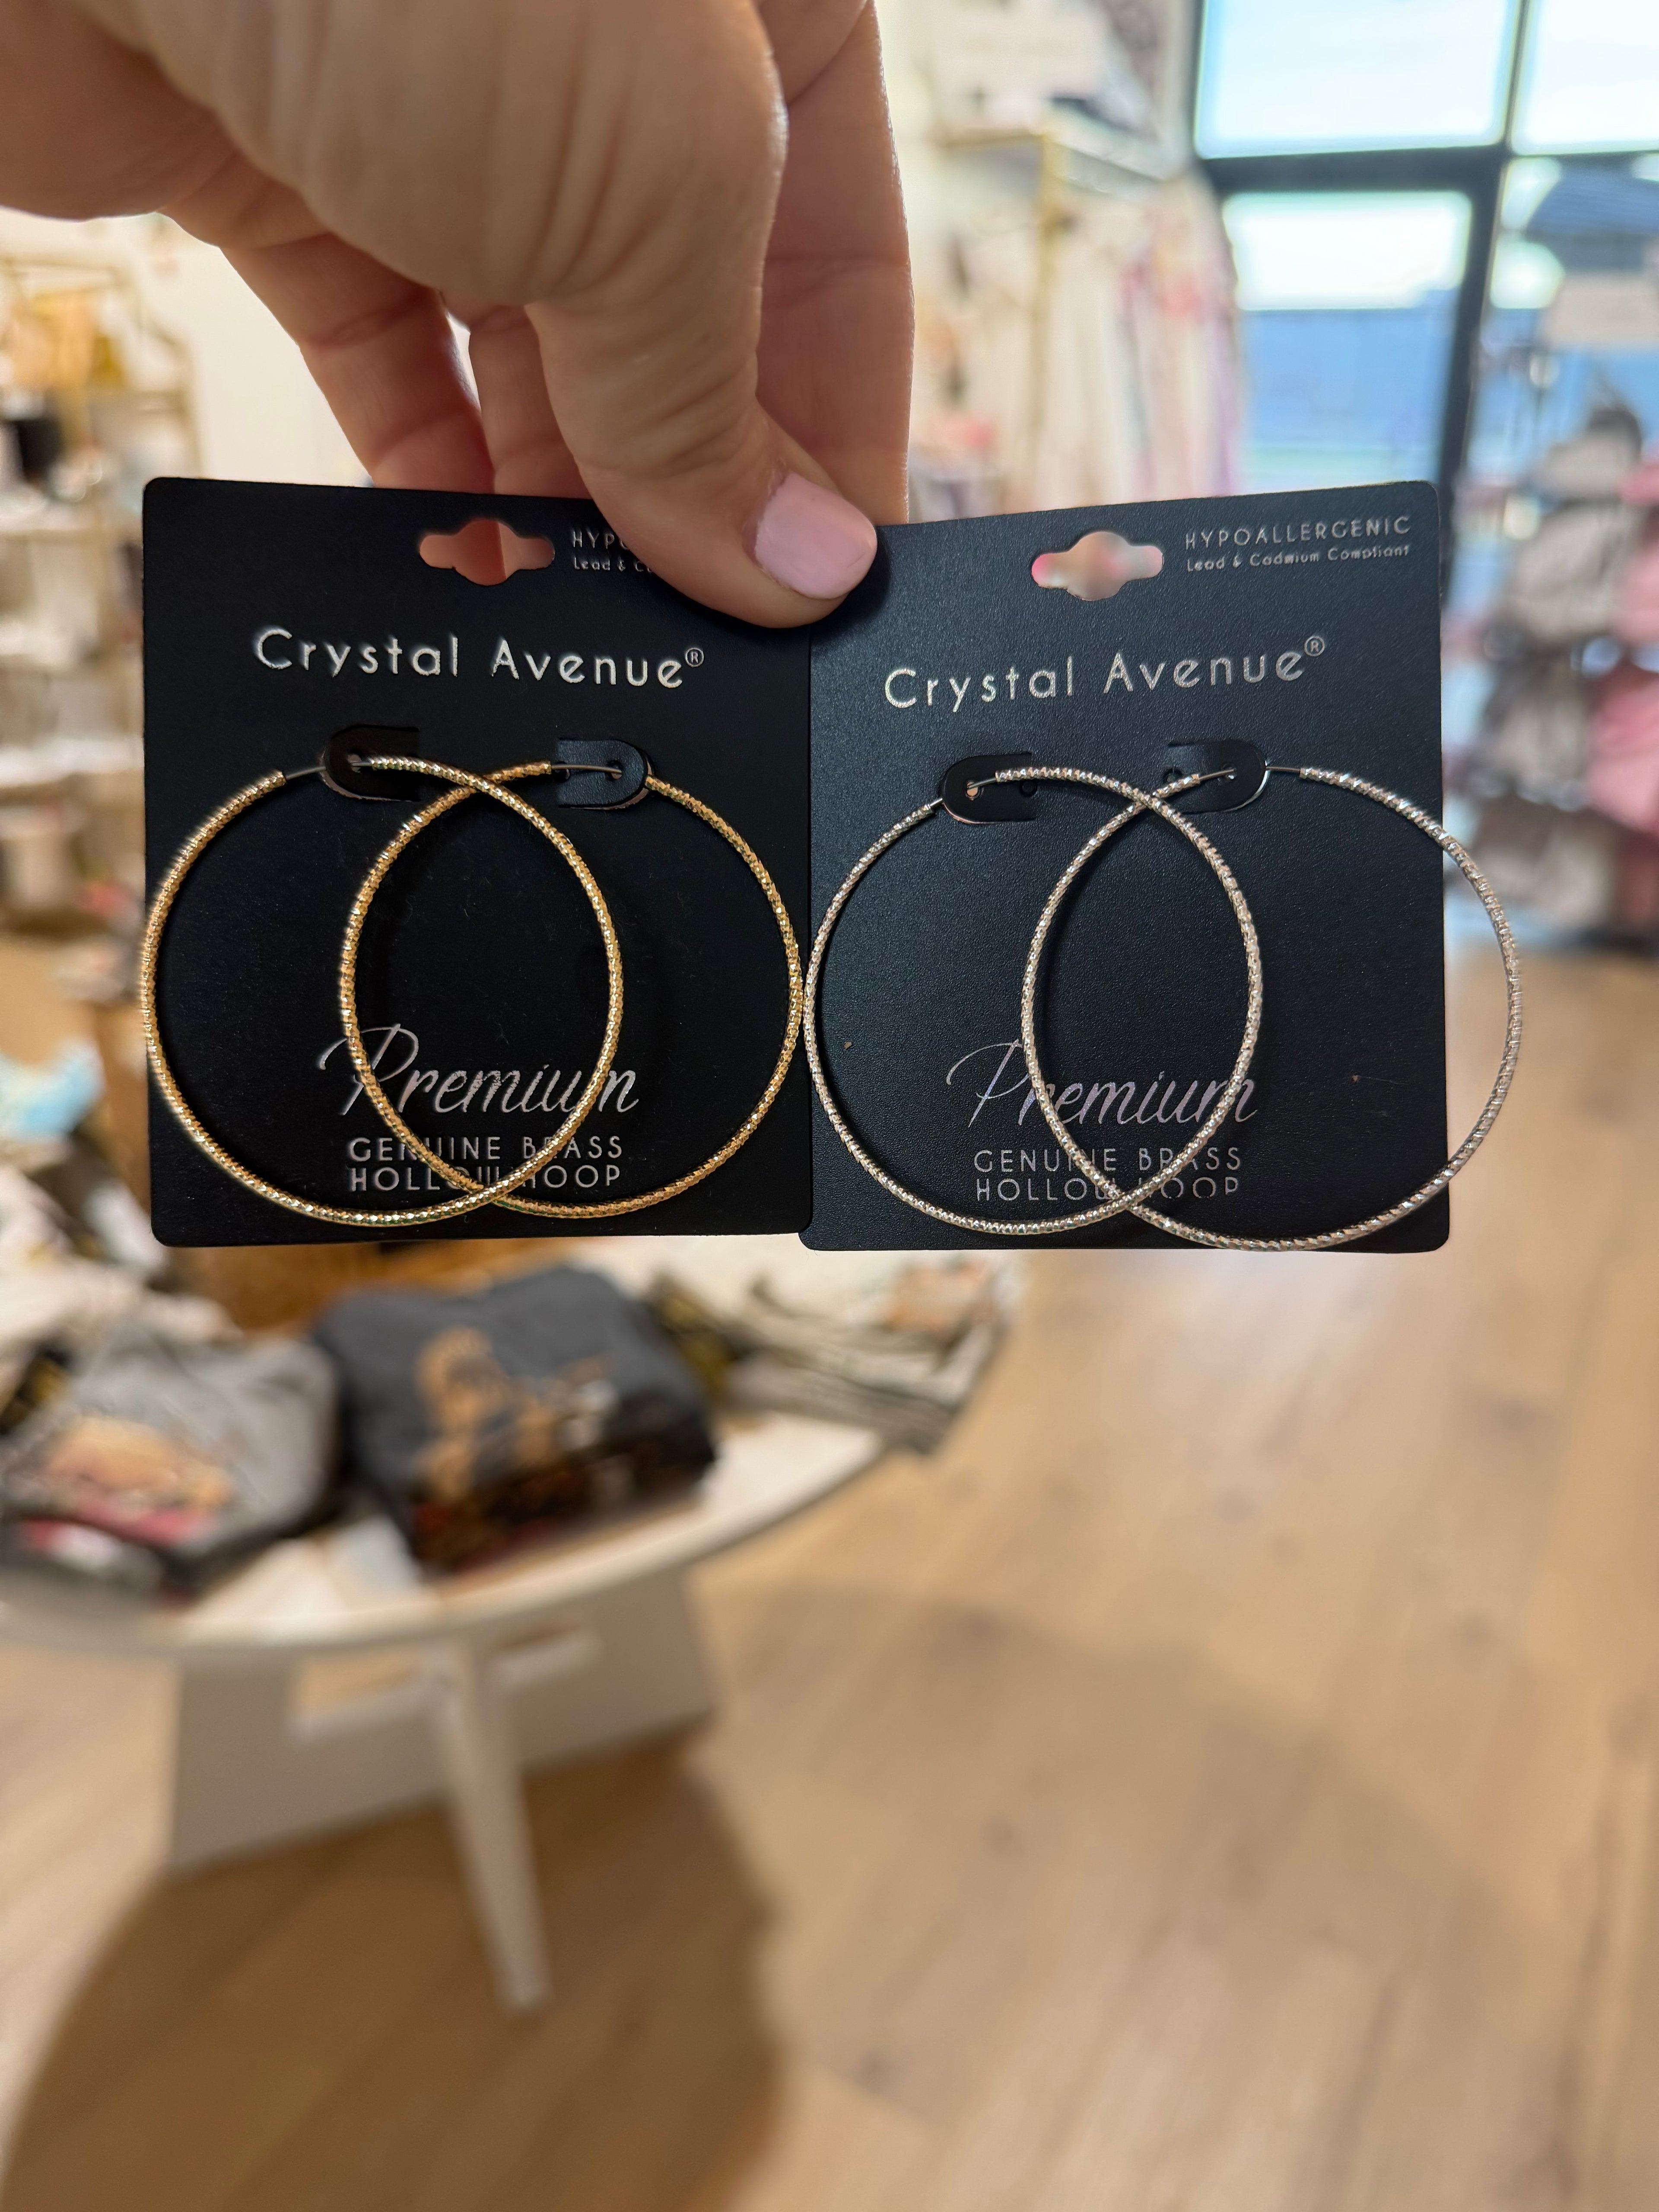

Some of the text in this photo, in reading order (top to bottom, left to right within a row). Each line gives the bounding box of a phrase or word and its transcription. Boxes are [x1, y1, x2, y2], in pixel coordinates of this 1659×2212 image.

[1185, 516, 1410, 550] HYPOALLERGENIC
[573, 556, 610, 571] Lead
[1186, 558, 1225, 572] Lead
[1249, 551, 1319, 567] Cadmium
[1328, 543, 1410, 561] Compliant
[257, 627, 459, 678] Crystal
[884, 656, 1073, 713] Crystal
[318, 1023, 639, 1116] Premium
[946, 1038, 1259, 1128] Premium
[522, 1135, 623, 1159] BASS
[1138, 1176, 1239, 1199] OOP
